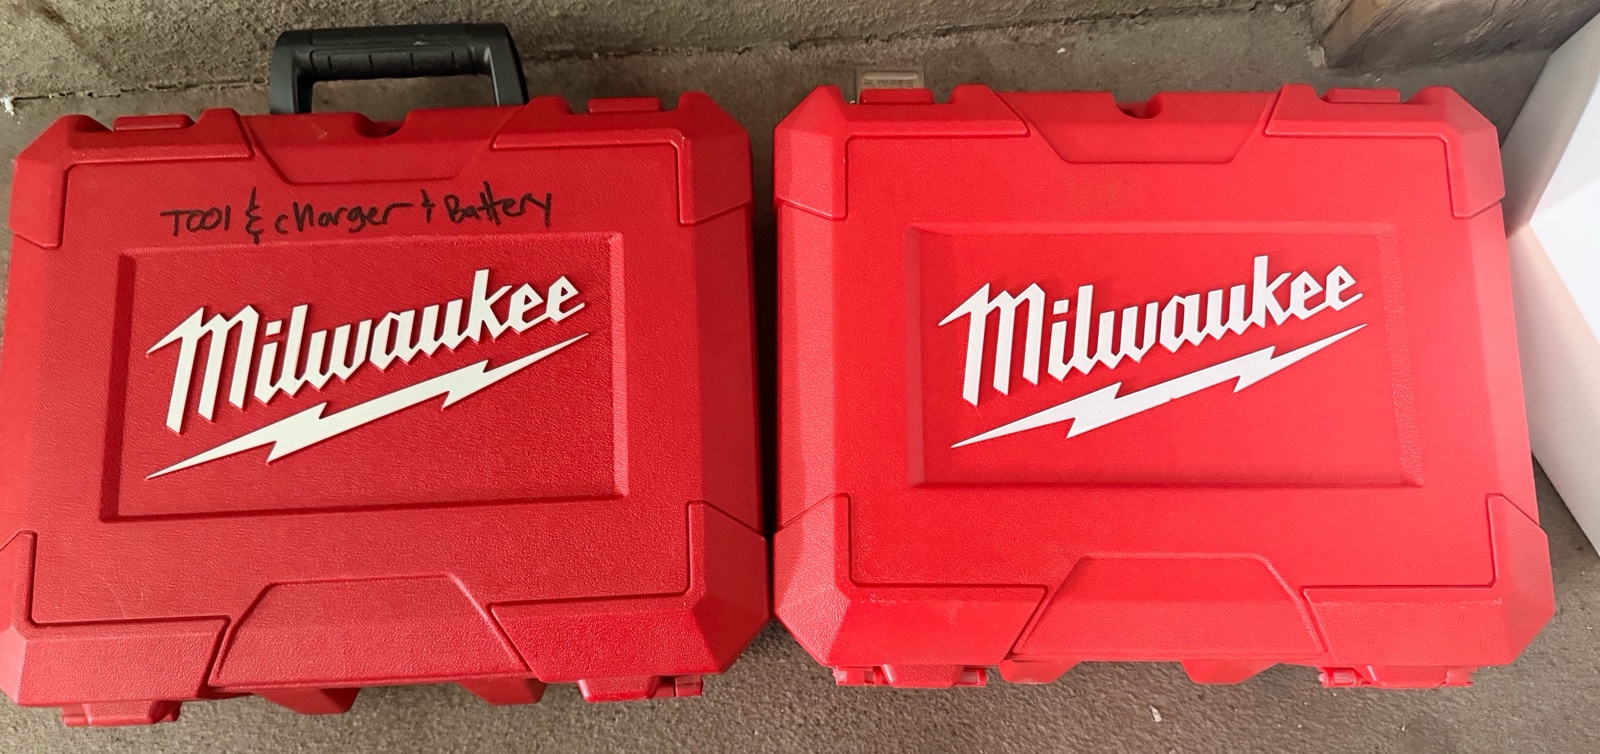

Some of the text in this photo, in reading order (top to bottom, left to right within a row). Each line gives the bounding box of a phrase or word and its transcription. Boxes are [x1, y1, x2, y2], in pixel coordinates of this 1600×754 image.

[443, 180, 552, 228] Battery
[146, 268, 586, 434] Milwaukee
[938, 255, 1364, 407] Milwaukee
